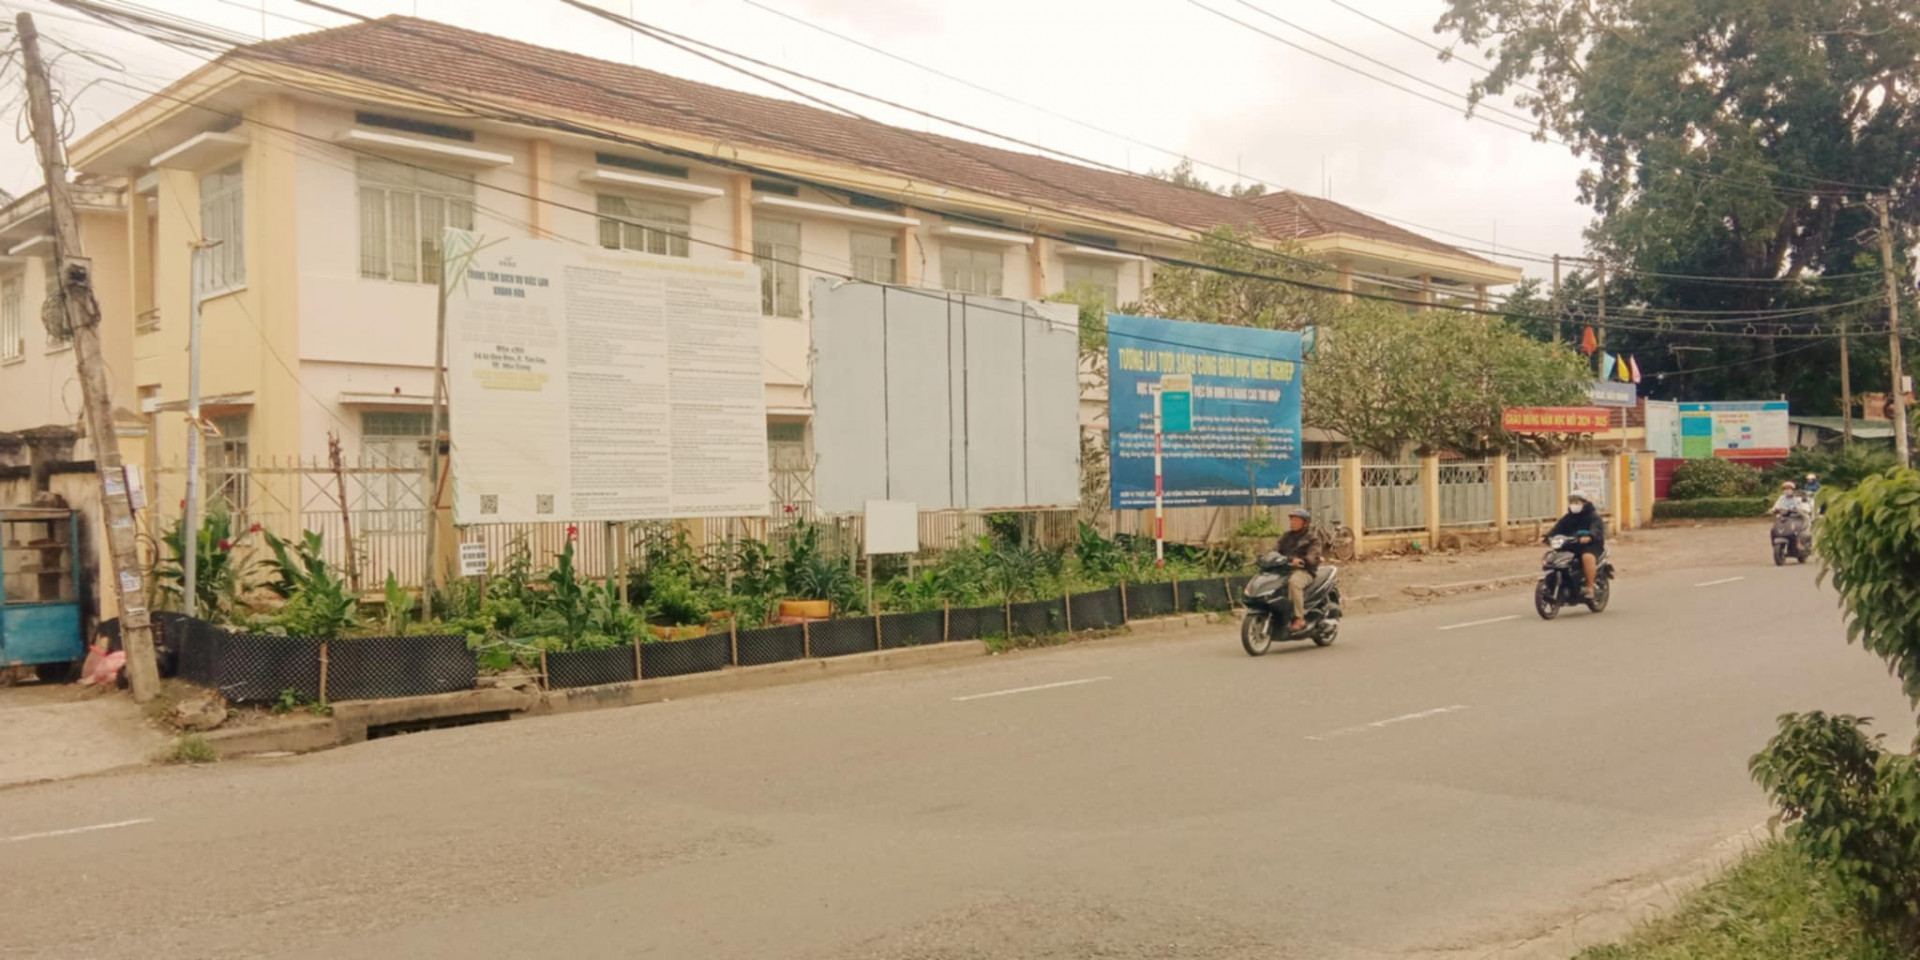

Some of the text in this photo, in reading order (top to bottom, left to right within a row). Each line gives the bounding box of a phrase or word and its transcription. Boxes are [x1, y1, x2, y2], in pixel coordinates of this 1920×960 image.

[1118, 348, 1145, 371] TƯƠNG
[1145, 351, 1157, 372] LAI
[1158, 351, 1175, 373] TƯƠI
[1176, 350, 1196, 374] SÁNG
[1218, 354, 1235, 377] GIÁO
[1251, 354, 1269, 380] NGHỀ
